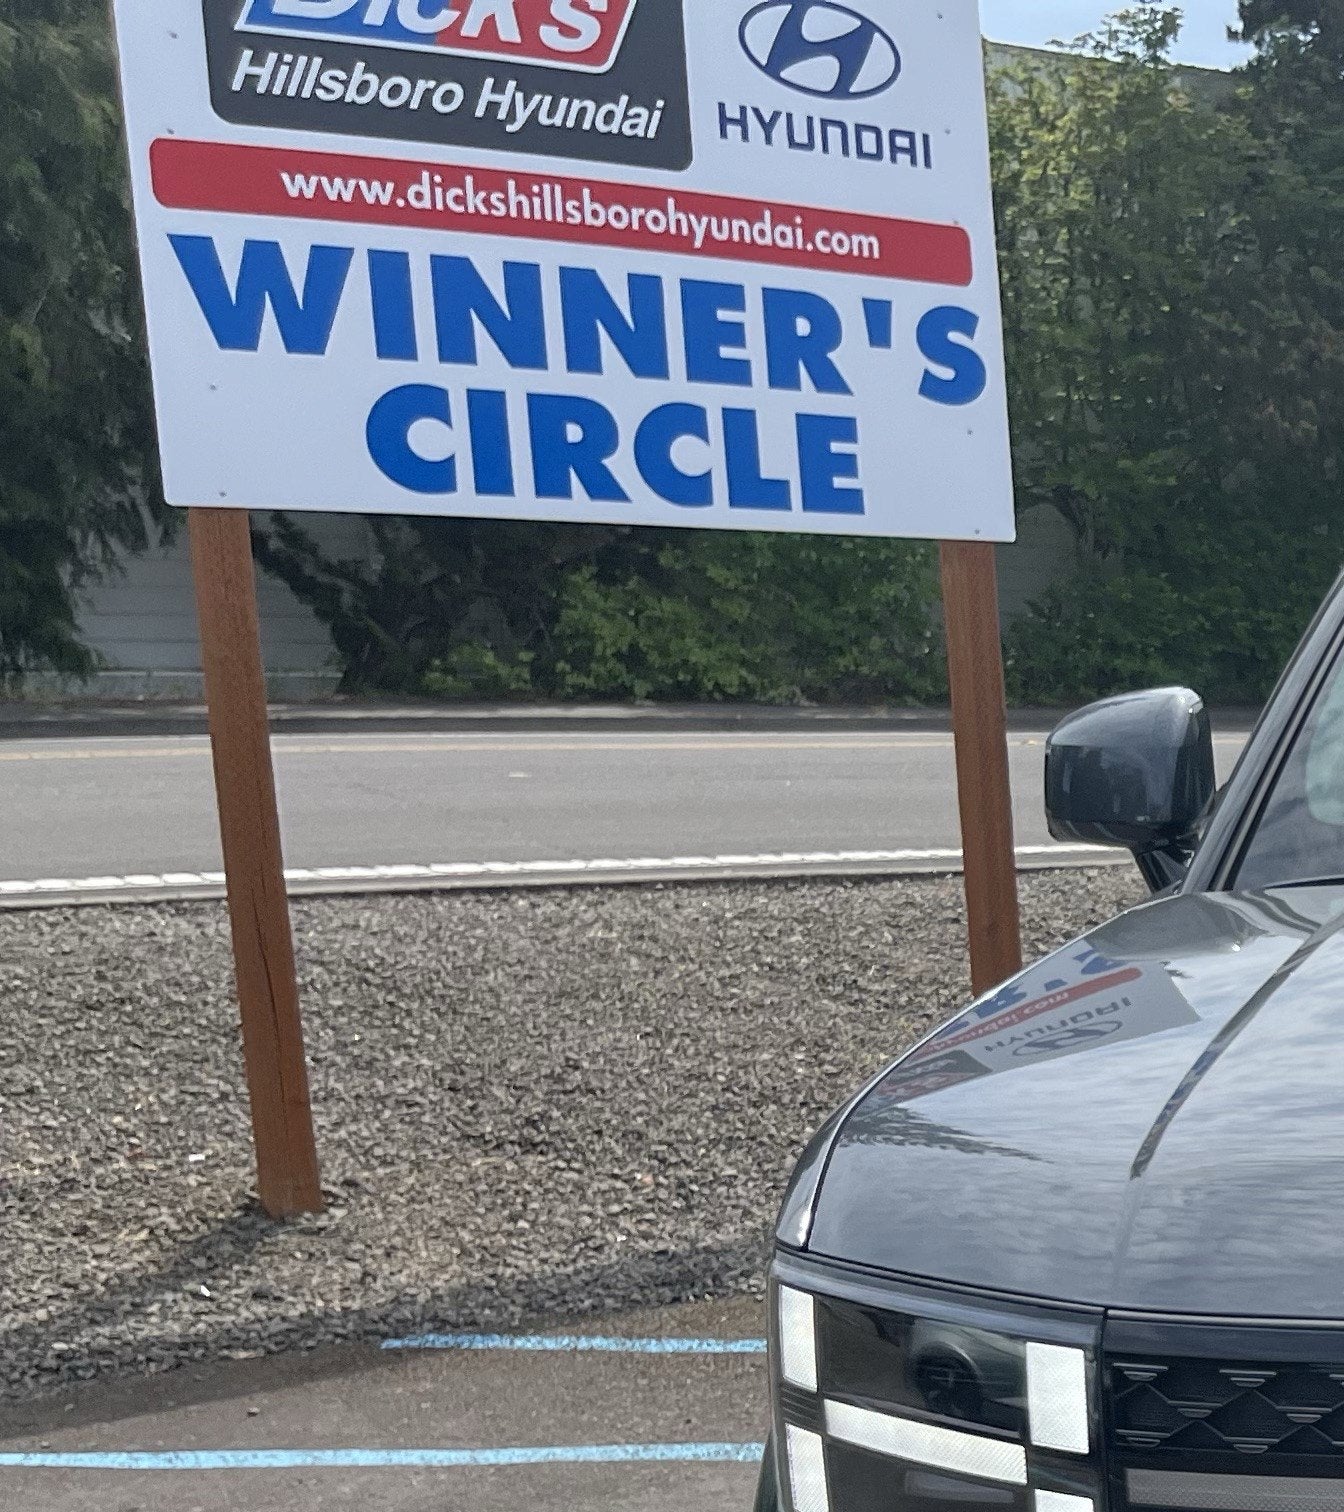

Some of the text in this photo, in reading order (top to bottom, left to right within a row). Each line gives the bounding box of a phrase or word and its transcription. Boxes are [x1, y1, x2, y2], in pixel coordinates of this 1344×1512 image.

[231, 48, 665, 140] Hillsboro Hyundai
[718, 103, 932, 170] HYUNDAI
[281, 169, 882, 261] www.dickshillsborohyundai.com
[166, 233, 988, 407] WINNER'S
[365, 383, 866, 516] CIRCLE
